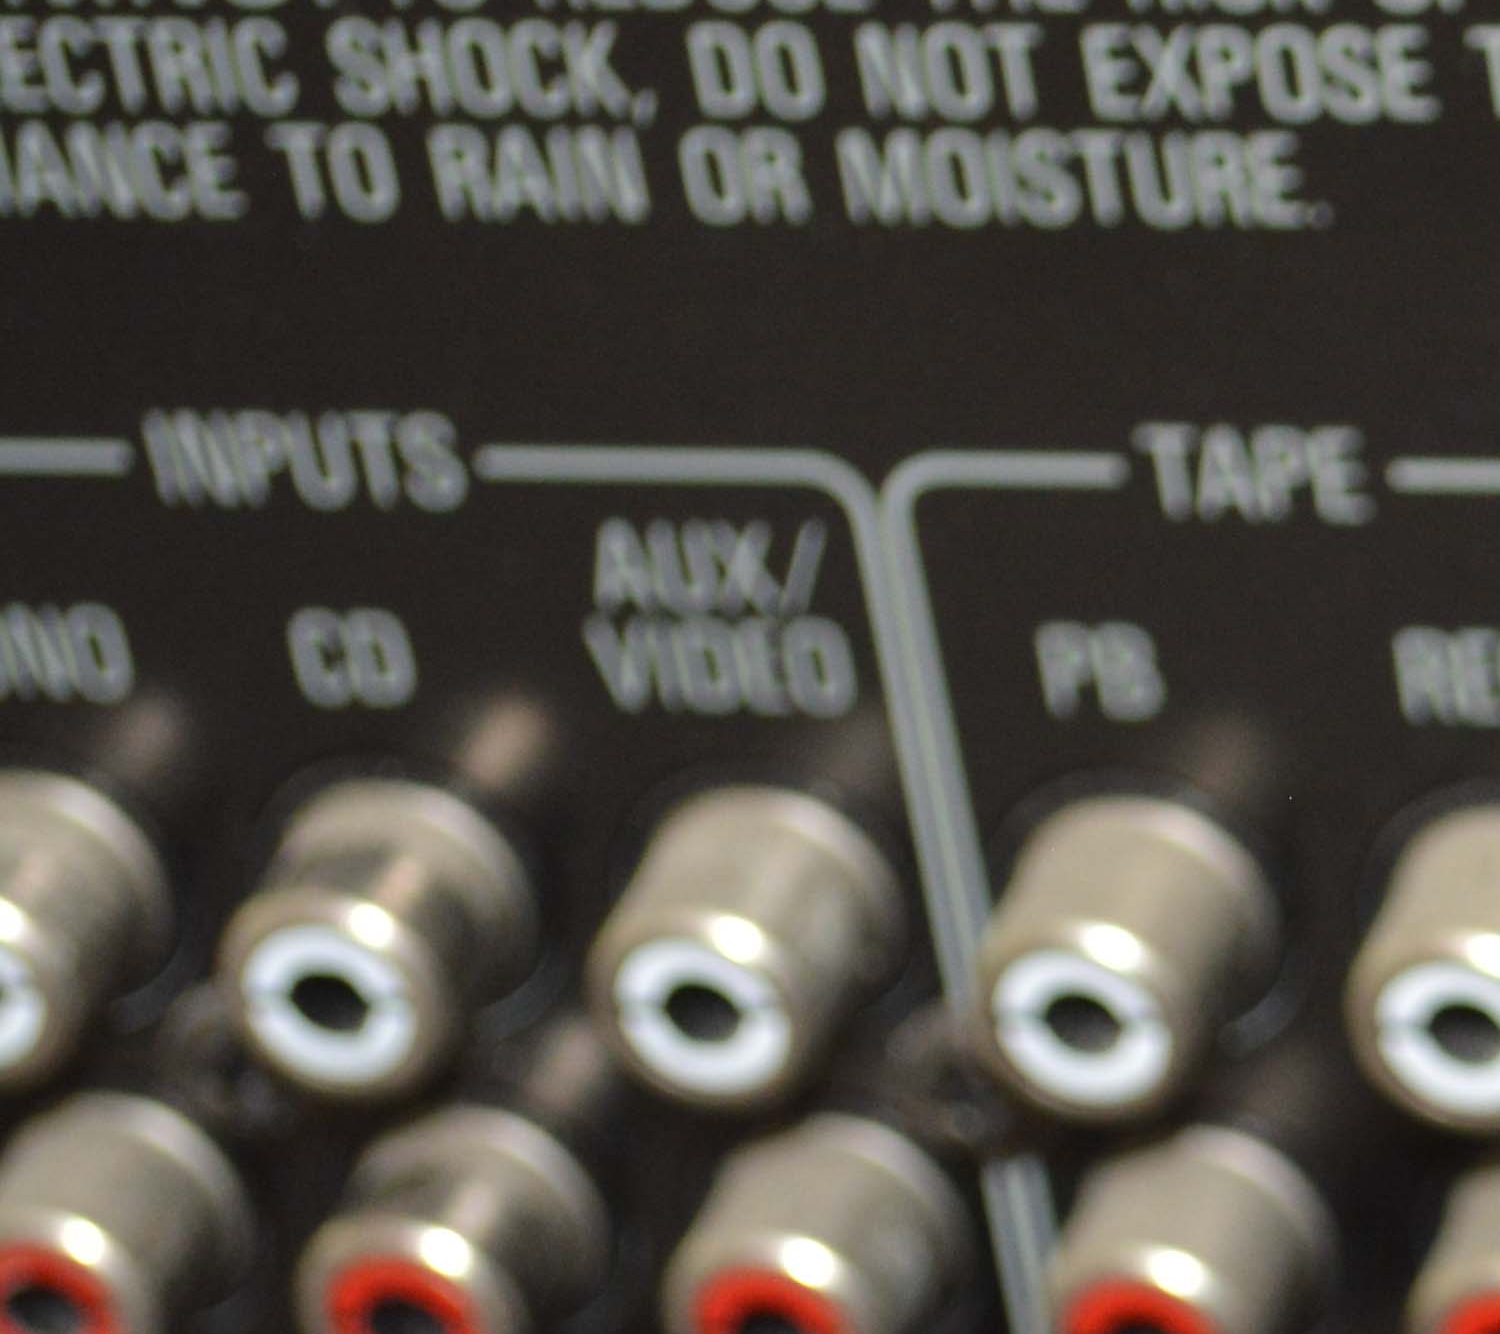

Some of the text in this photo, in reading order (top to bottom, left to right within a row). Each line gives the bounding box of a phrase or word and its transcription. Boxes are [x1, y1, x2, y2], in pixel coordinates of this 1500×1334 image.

[687, 21, 824, 119] DO
[855, 22, 1038, 120] NOT
[1081, 24, 1436, 122] EXPOSE
[269, 122, 399, 221] TO
[428, 124, 649, 221] RAIN
[679, 126, 810, 224] OR
[837, 128, 1330, 228] MOISTURE.
[143, 410, 467, 509] INPUTS
[1137, 423, 1366, 523] TAPE
[595, 520, 823, 612] AUX/
[0, 605, 133, 702] NO
[288, 609, 416, 705] CD
[585, 615, 856, 718] VIDEO
[1036, 623, 1163, 719] PB
